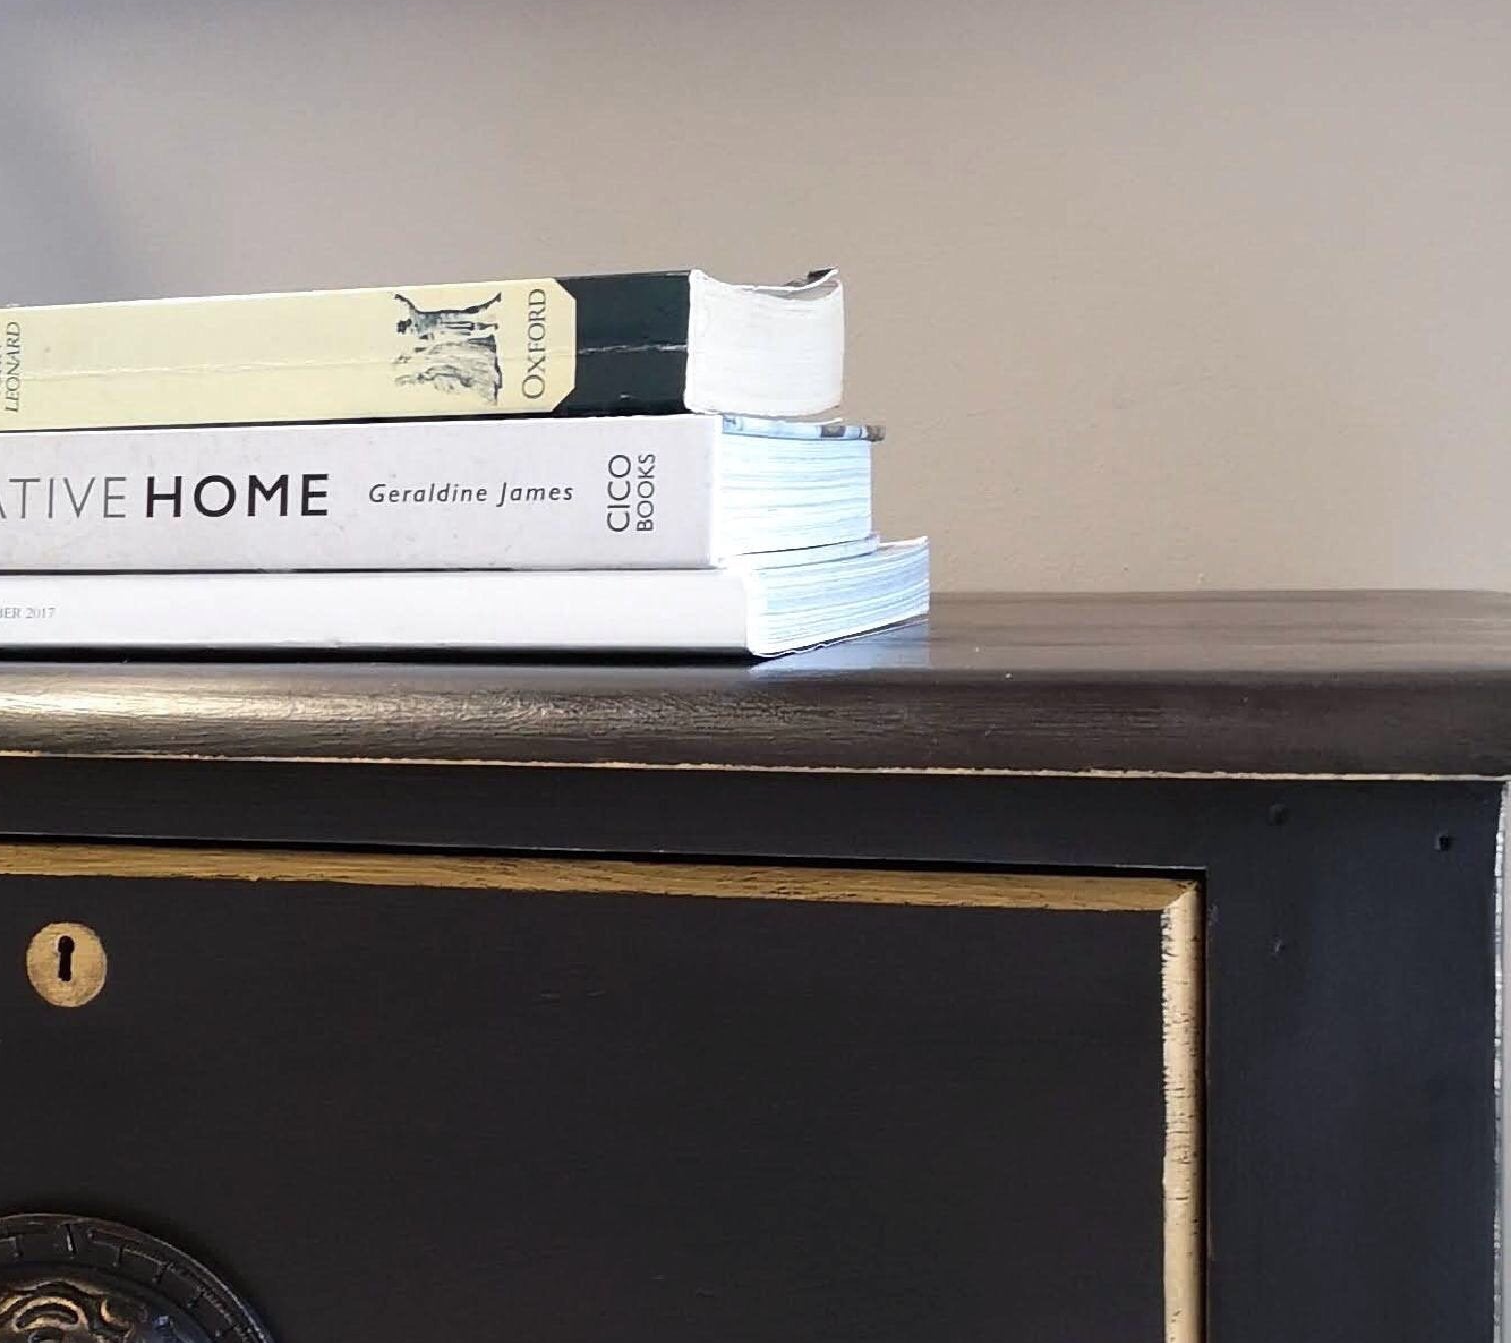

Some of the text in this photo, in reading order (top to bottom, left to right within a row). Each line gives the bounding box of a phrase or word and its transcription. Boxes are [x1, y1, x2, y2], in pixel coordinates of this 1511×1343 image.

[5, 321, 21, 413] LEONARD
[522, 288, 547, 399] OXFORD
[145, 473, 328, 518] HOME
[369, 482, 574, 507] Geraldine James
[607, 454, 631, 533] CICO
[637, 454, 656, 532] BOOKS
[25, 607, 56, 619] 2017
